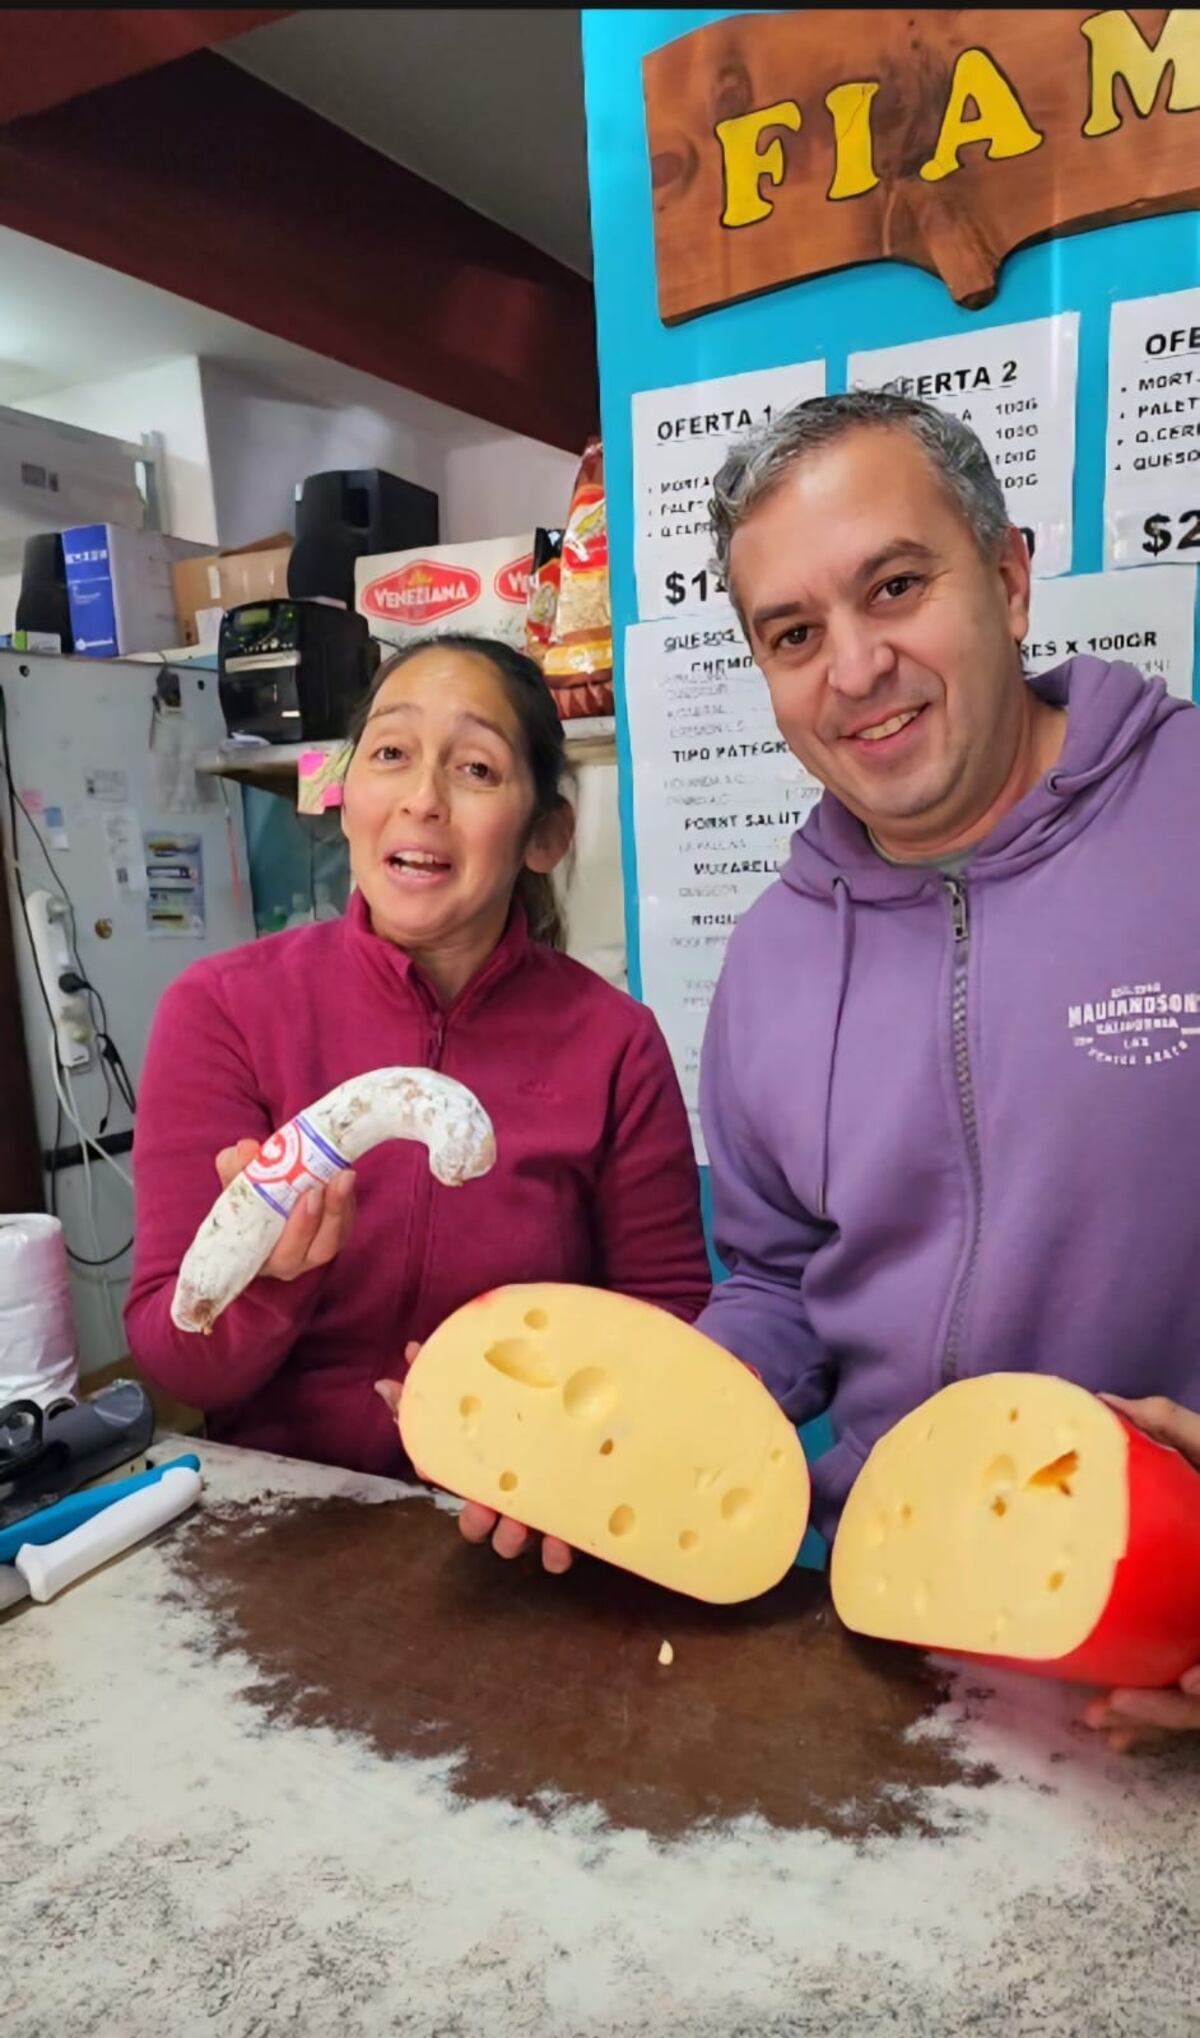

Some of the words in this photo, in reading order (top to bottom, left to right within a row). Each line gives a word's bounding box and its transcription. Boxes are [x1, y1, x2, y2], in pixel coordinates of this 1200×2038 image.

[714, 10, 1200, 229] FIAM
[898, 366, 991, 397] FERTA
[1001, 360, 1018, 383] 2
[657, 408, 752, 441] OFERTA
[763, 404, 772, 424] 1
[374, 580, 470, 609] VENEZIANA
[1087, 631, 1158, 653] 100GR
